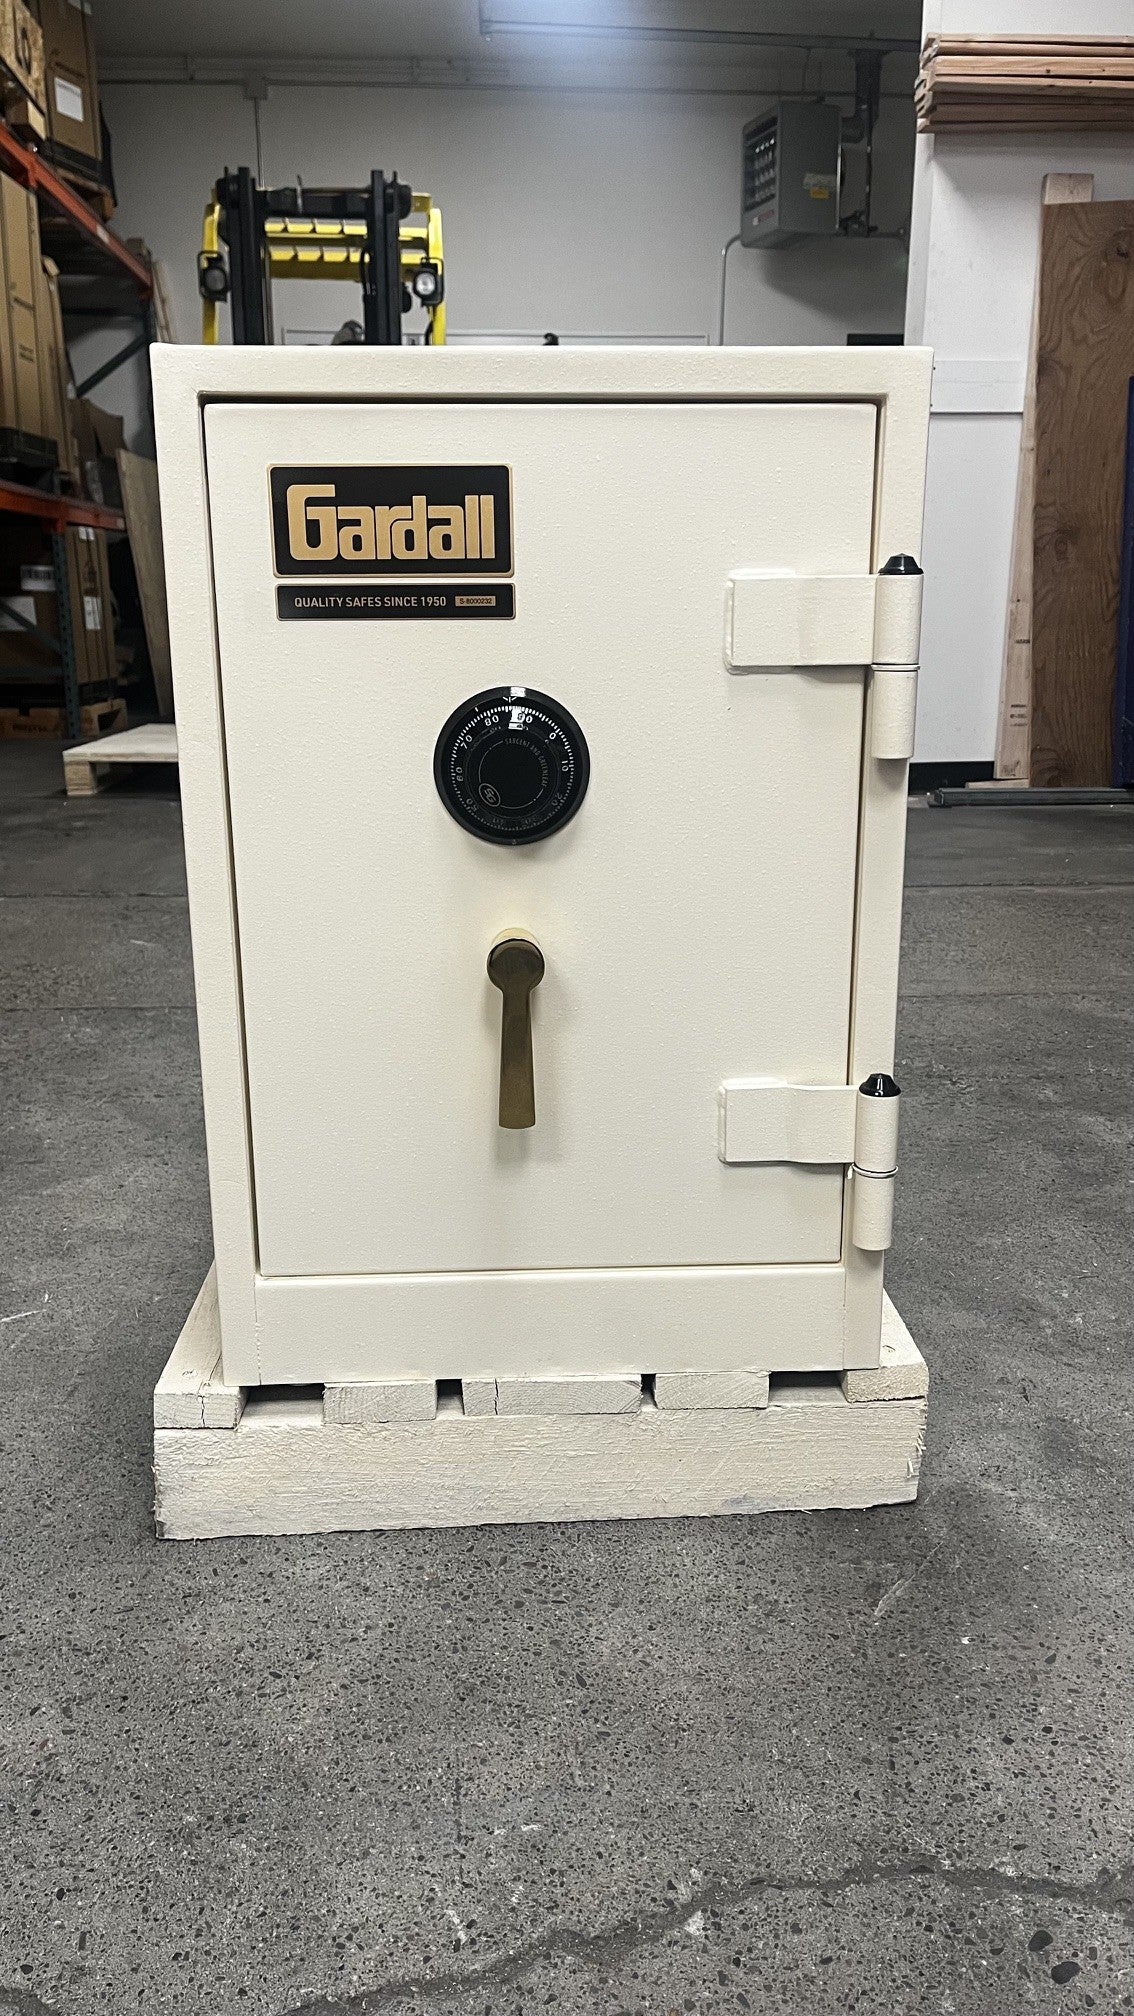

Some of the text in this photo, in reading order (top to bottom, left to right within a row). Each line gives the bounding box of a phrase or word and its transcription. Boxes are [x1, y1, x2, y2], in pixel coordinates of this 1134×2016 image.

[286, 484, 496, 561] Gardall
[294, 596, 447, 608] QUALITY SAFES SINCE 1950
[484, 715, 500, 727] 80
[460, 735, 473, 750] 70
[561, 760, 569, 772] 10
